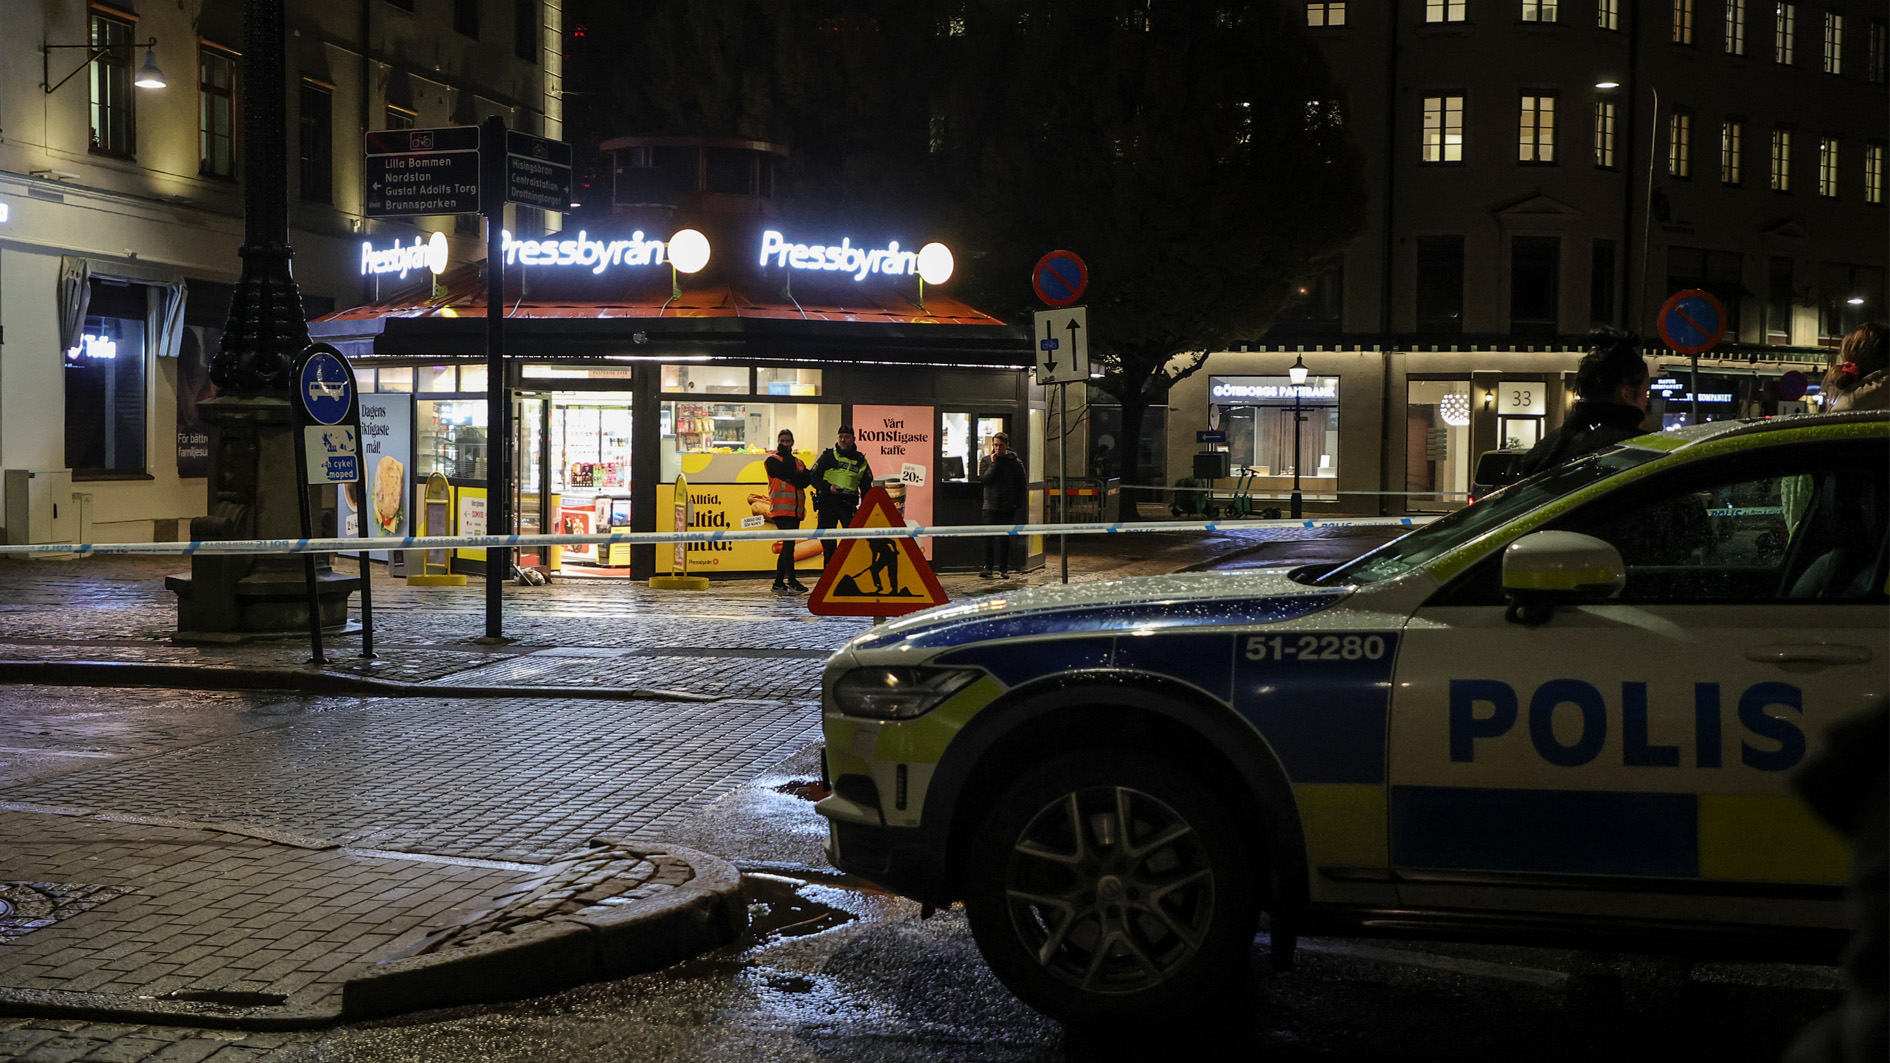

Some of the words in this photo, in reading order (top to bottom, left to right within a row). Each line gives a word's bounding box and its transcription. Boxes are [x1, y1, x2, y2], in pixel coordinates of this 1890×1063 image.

[385, 159, 405, 169] Lilla
[409, 158, 451, 168] Bommen
[386, 173, 431, 182] Nordstan
[511, 173, 558, 191] Centralstation
[386, 186, 416, 196] Gustaf
[420, 184, 451, 195] Adolfs
[455, 184, 477, 195] Torg
[386, 199, 457, 210] Brunnsparken
[361, 236, 431, 279] Pressbyrån
[759, 230, 916, 282] Pressbyrån
[1213, 383, 1278, 397] GÖTEBORGS
[1512, 390, 1531, 407] 33
[361, 405, 386, 419] Dagens
[361, 422, 390, 438] iktigaste
[883, 418, 904, 429] Vårt
[178, 433, 190, 444] För
[858, 429, 928, 444] konstigaste
[178, 447, 208, 459] familjesu
[366, 440, 381, 454] mål!
[880, 445, 906, 455] kaffe
[333, 459, 353, 469] cykel
[330, 470, 354, 480] moped
[902, 471, 923, 483] 20:-
[689, 494, 722, 506] Alltid,
[688, 510, 730, 529] ltid,
[1245, 635, 1386, 661] 51-2280
[1448, 678, 1806, 772] POLIS
